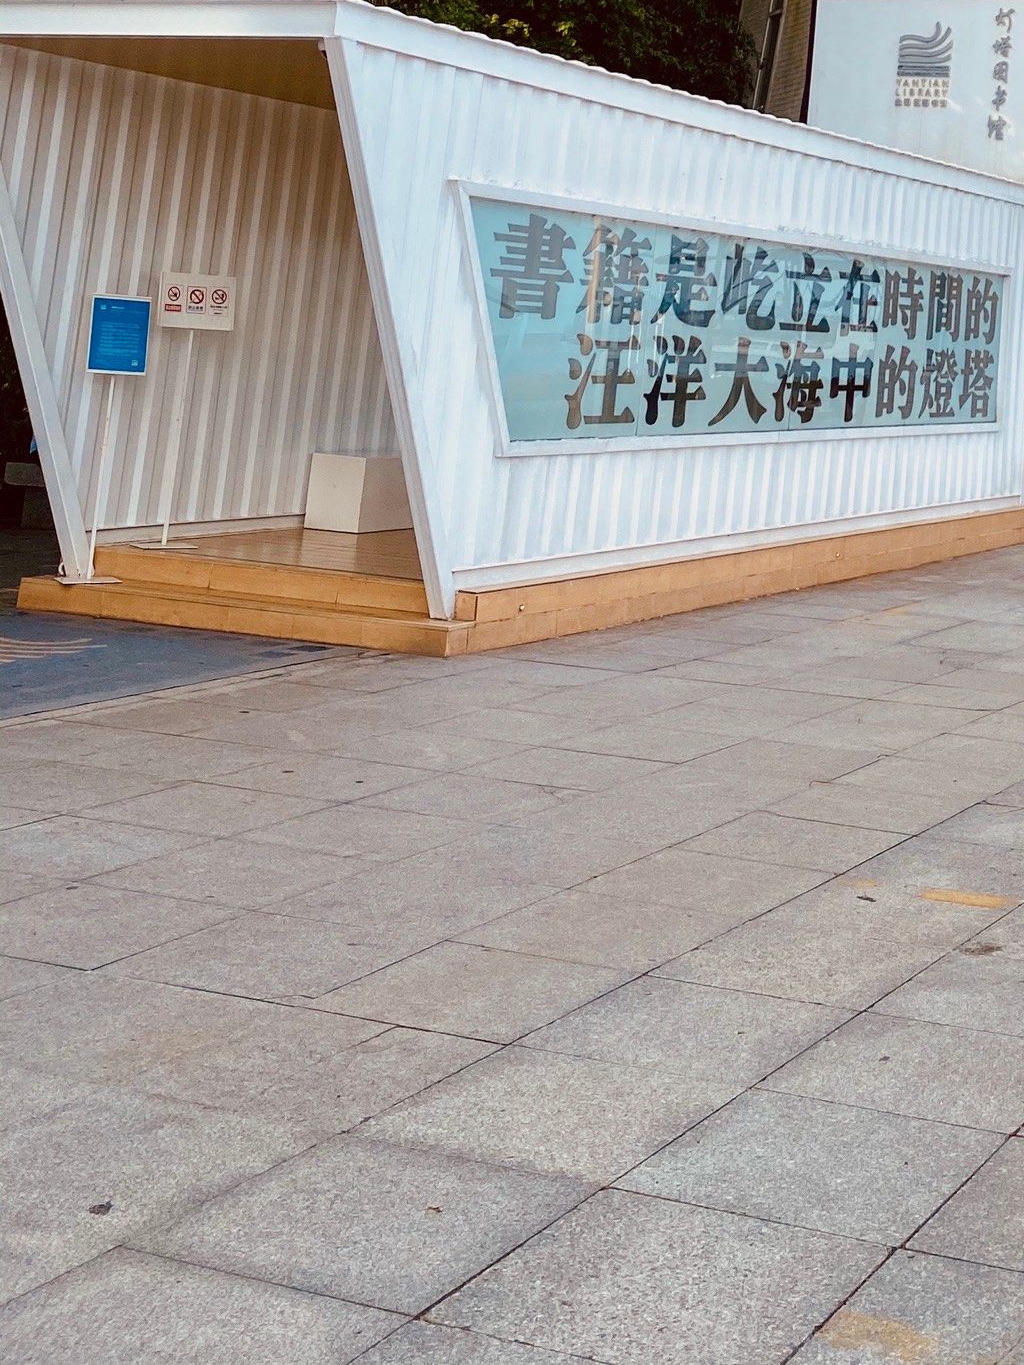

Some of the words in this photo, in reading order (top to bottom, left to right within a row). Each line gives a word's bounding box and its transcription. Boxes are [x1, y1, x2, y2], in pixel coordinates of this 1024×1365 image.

[895, 88, 949, 97] LIBRARY
[490, 213, 999, 345] 書籍是屹立在時間的
[565, 332, 996, 430] 汪洋大海中的燈塔
